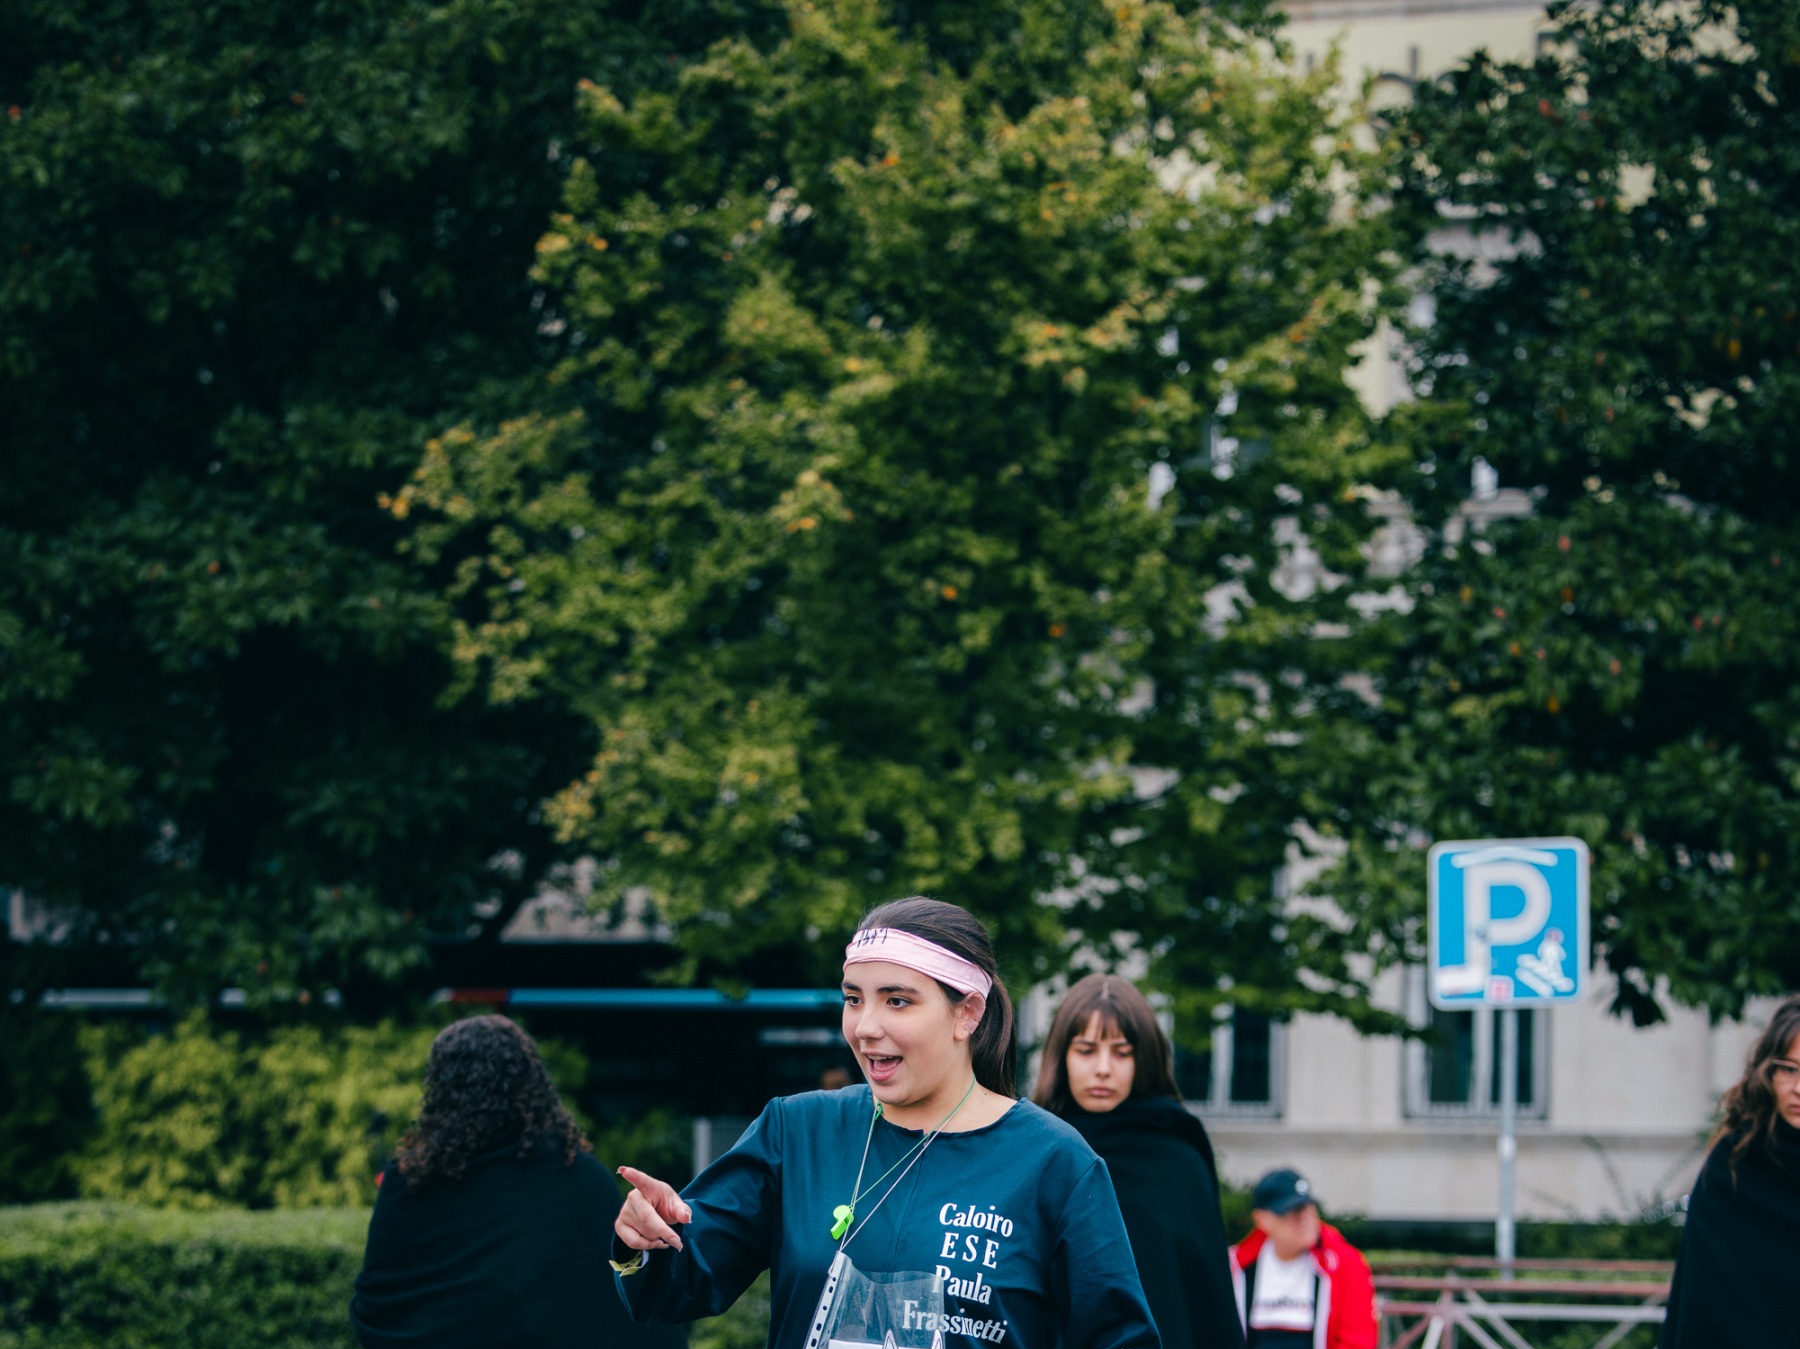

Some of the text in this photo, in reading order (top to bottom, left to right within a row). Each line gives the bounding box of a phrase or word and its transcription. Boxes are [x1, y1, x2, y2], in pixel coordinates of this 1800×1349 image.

[1463, 861, 1552, 988] P
[939, 1203, 1014, 1237] Caloiro
[931, 1265, 993, 1305] Paula
[902, 1299, 1008, 1344] Frassinetti
